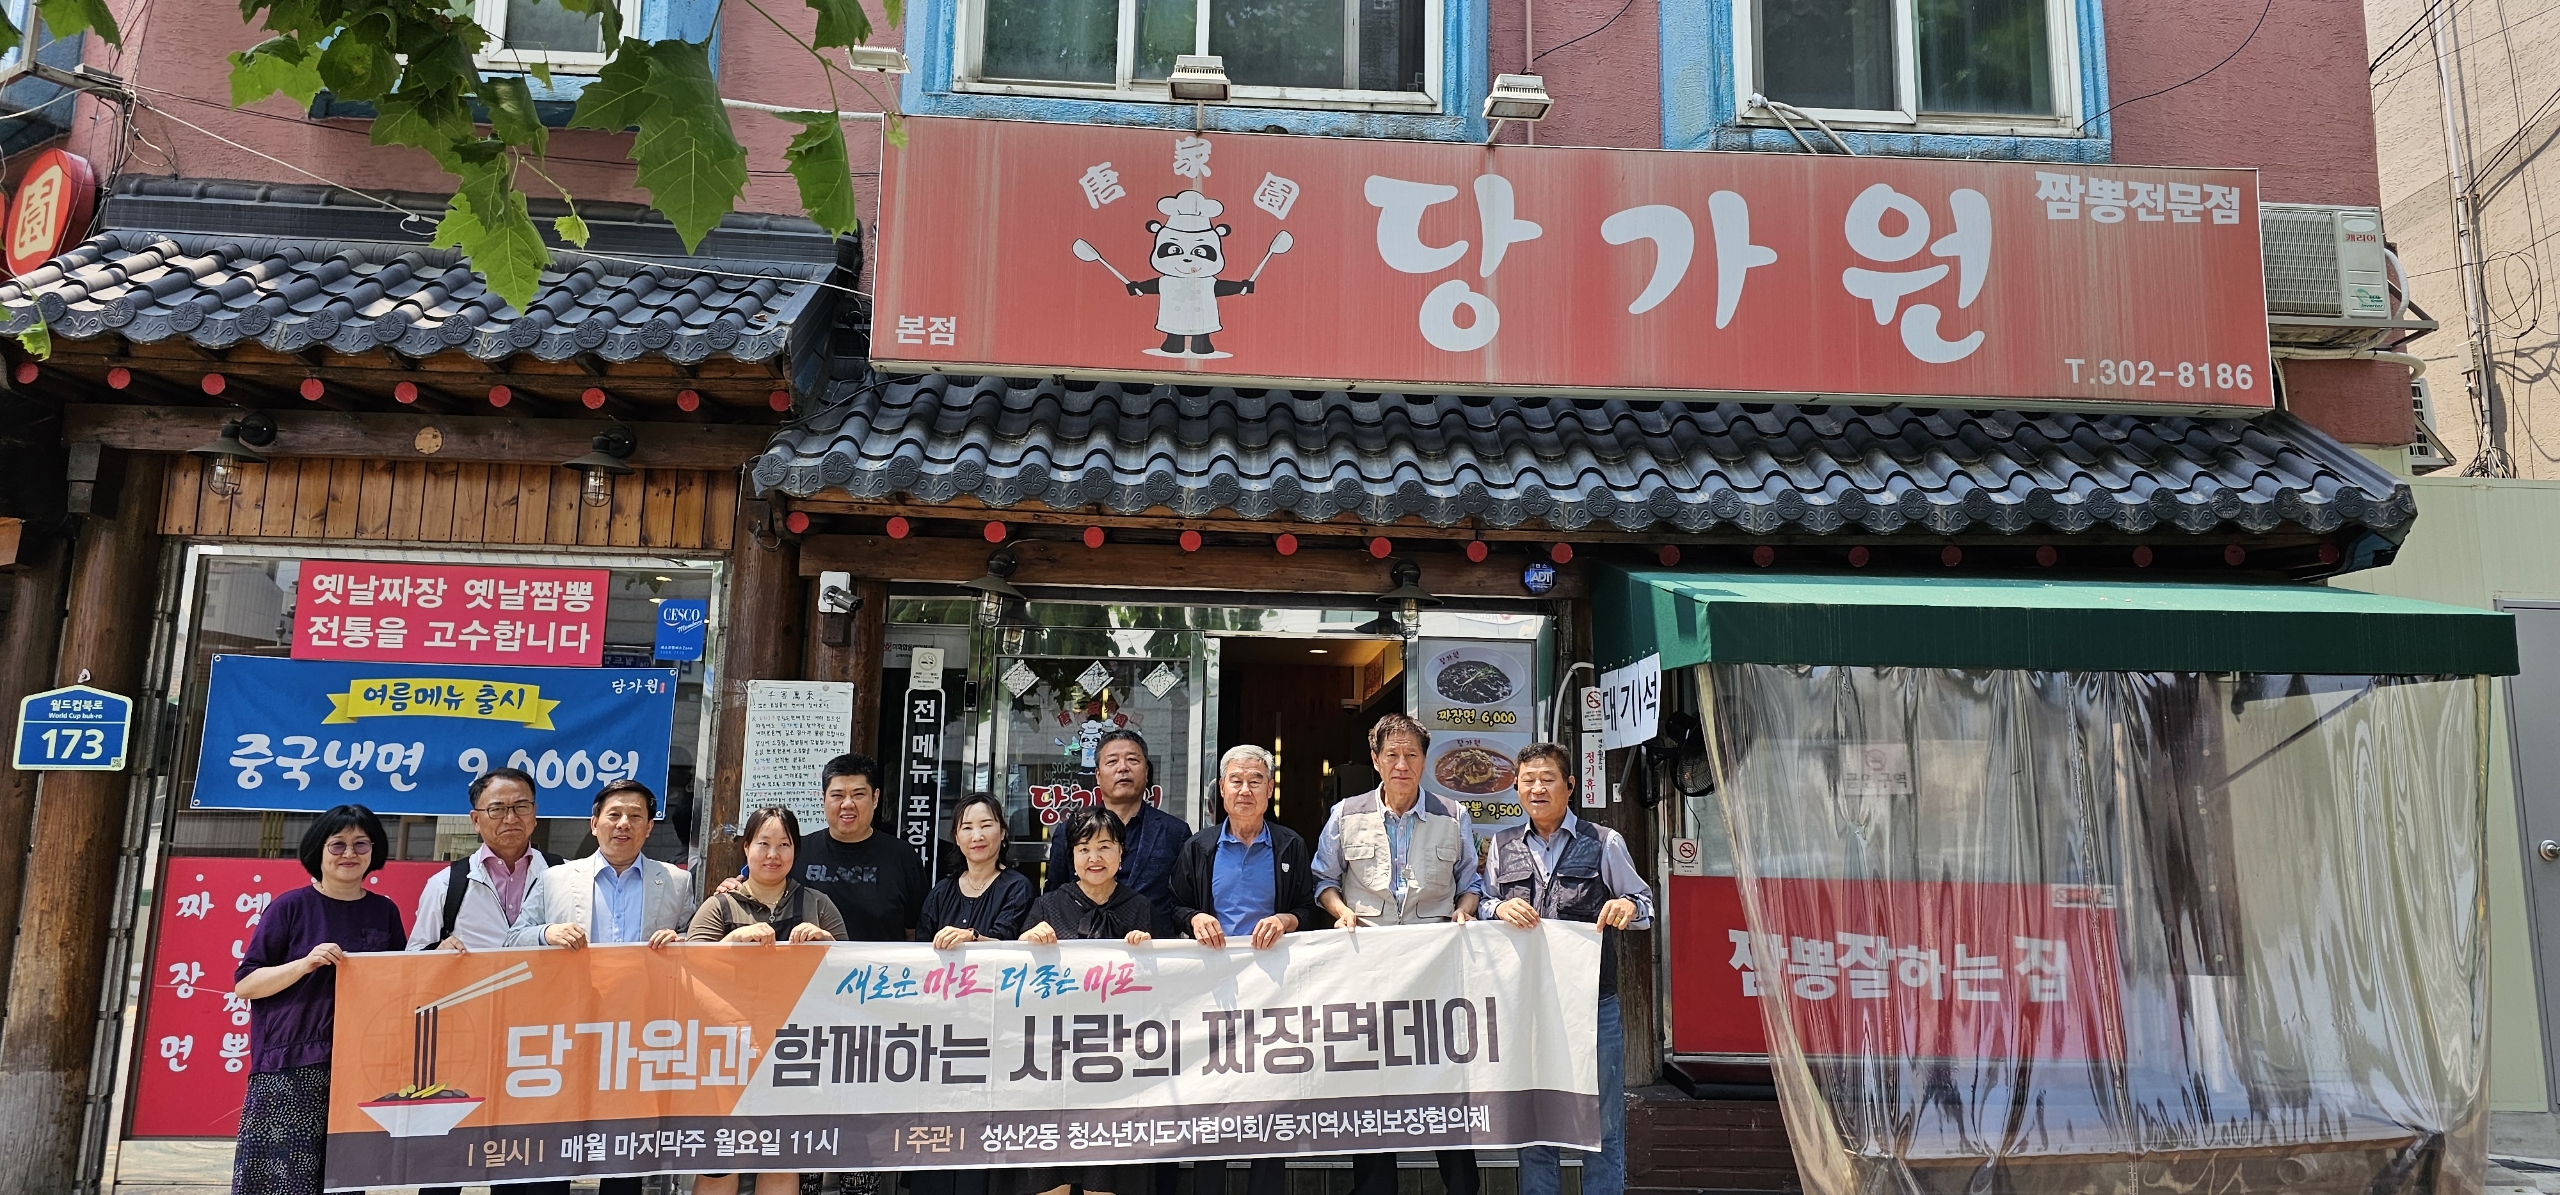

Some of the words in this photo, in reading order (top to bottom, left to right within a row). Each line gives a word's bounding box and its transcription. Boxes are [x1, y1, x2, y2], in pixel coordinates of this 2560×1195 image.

[2036, 171, 2241, 226] 짬뽕전문점
[2346, 233, 2376, 242] 캐리어
[1364, 172, 1993, 364] 당가원
[895, 315, 956, 346] 본점
[2065, 358, 2253, 391] T.302-8186
[312, 573, 448, 608] 옛날짜장
[464, 578, 595, 612] 옛날짬뽕
[1531, 572, 1550, 582] ADT
[664, 608, 700, 621] CESCO
[307, 615, 408, 649] 전통을
[424, 620, 591, 654] 고수합니다
[363, 683, 466, 713] 여름메뉴
[475, 684, 526, 715] 출시
[612, 678, 658, 694] 당가원
[1602, 671, 1657, 731] 대기석
[50, 699, 104, 712] 월드컵북로
[913, 700, 936, 722] 전
[1437, 708, 1476, 726] 짜장면
[1480, 712, 1516, 726] 6,000
[42, 728, 104, 760] 173
[909, 734, 934, 784] 메뉴
[229, 734, 425, 791] 중국냉면
[1584, 752, 1596, 804] 정기휴일
[1487, 804, 1522, 820] 9,500
[1728, 929, 2004, 1001] 짬뽕잘하는
[2014, 935, 2067, 1002] 집
[836, 964, 918, 1004] 새로운
[922, 962, 994, 1001] 마포
[1000, 964, 1026, 1008] 더
[1028, 964, 1079, 997] 좋은
[1083, 960, 1153, 1005] 마포
[504, 1018, 757, 1098] 당가원과
[772, 1021, 990, 1088] 함께하는
[1010, 1014, 1180, 1084] 사랑의
[1202, 996, 1500, 1076] 짜장면데이
[482, 1138, 530, 1168] 일시
[560, 1132, 607, 1162] 매월
[614, 1128, 706, 1160] 마지막주
[714, 1128, 781, 1158] 월요일
[790, 1126, 839, 1156] 11시
[906, 1124, 952, 1154] 주관
[980, 1123, 1061, 1152] 성산2동
[1067, 1104, 1490, 1150] 청소년지도자협의회/동지역사회보장협의체
